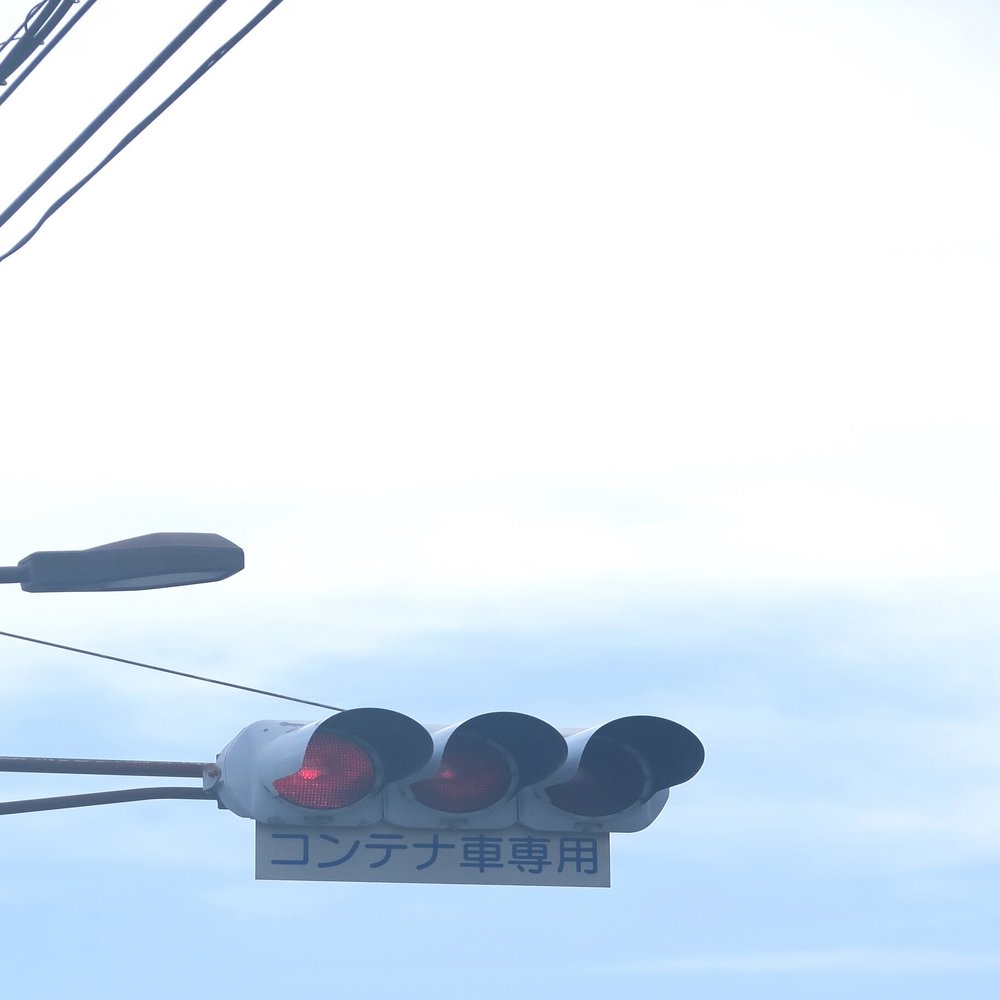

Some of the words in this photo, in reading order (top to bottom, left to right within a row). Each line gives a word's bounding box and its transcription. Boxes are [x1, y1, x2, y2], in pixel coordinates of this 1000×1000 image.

[270, 834, 599, 875] コンテナ車専用
